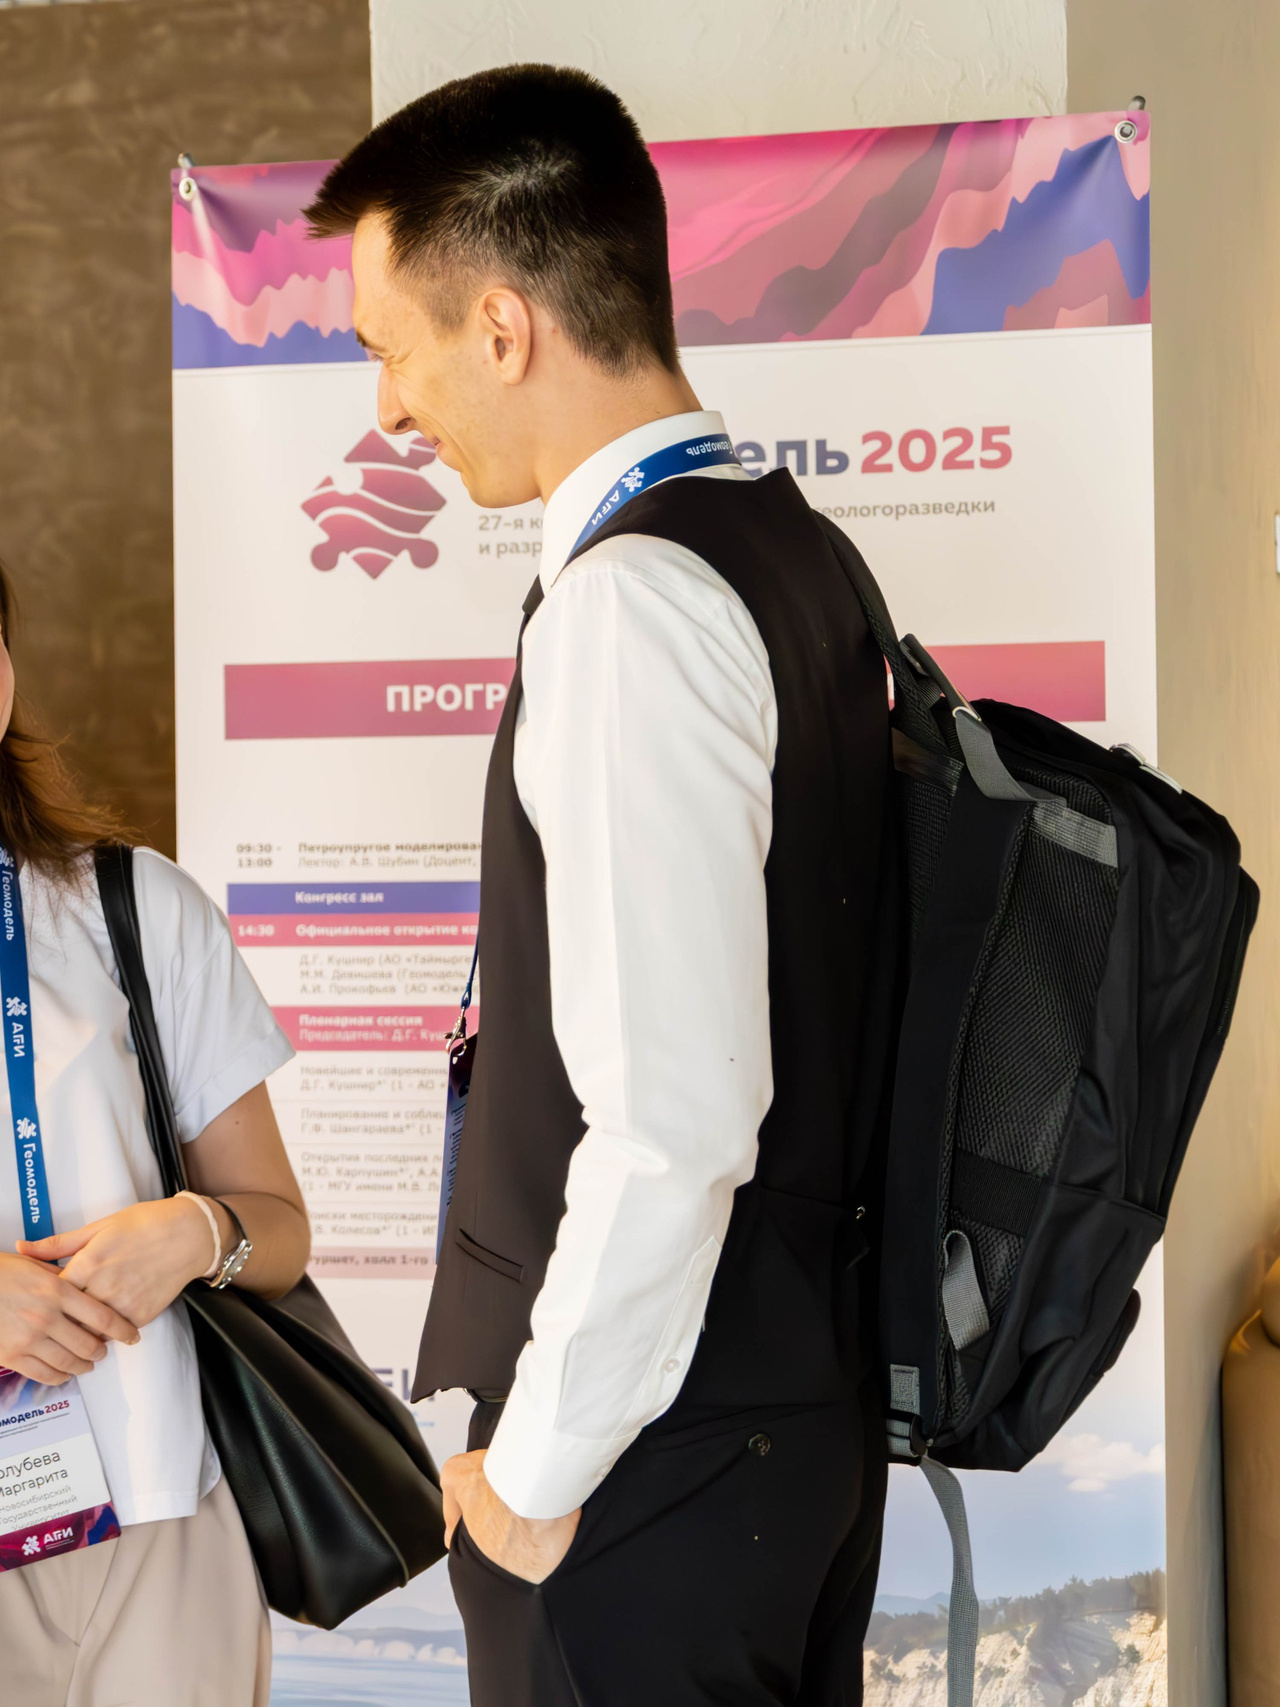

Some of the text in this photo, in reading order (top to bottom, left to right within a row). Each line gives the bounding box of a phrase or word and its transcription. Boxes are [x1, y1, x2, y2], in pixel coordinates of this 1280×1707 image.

[685, 440, 734, 457] Геомодель
[860, 425, 1013, 474] 2025
[478, 514, 543, 531] 27-я к
[478, 542, 491, 556] и
[386, 683, 507, 712] ПРОГР
[1, 869, 15, 942] Геомодель
[294, 891, 384, 905] Конгресс зал
[237, 924, 275, 937] 14:30
[295, 924, 391, 939] Официальное
[393, 923, 458, 938] открытие
[23, 1142, 42, 1224] Геомодель
[45, 1399, 71, 1414] 2025
